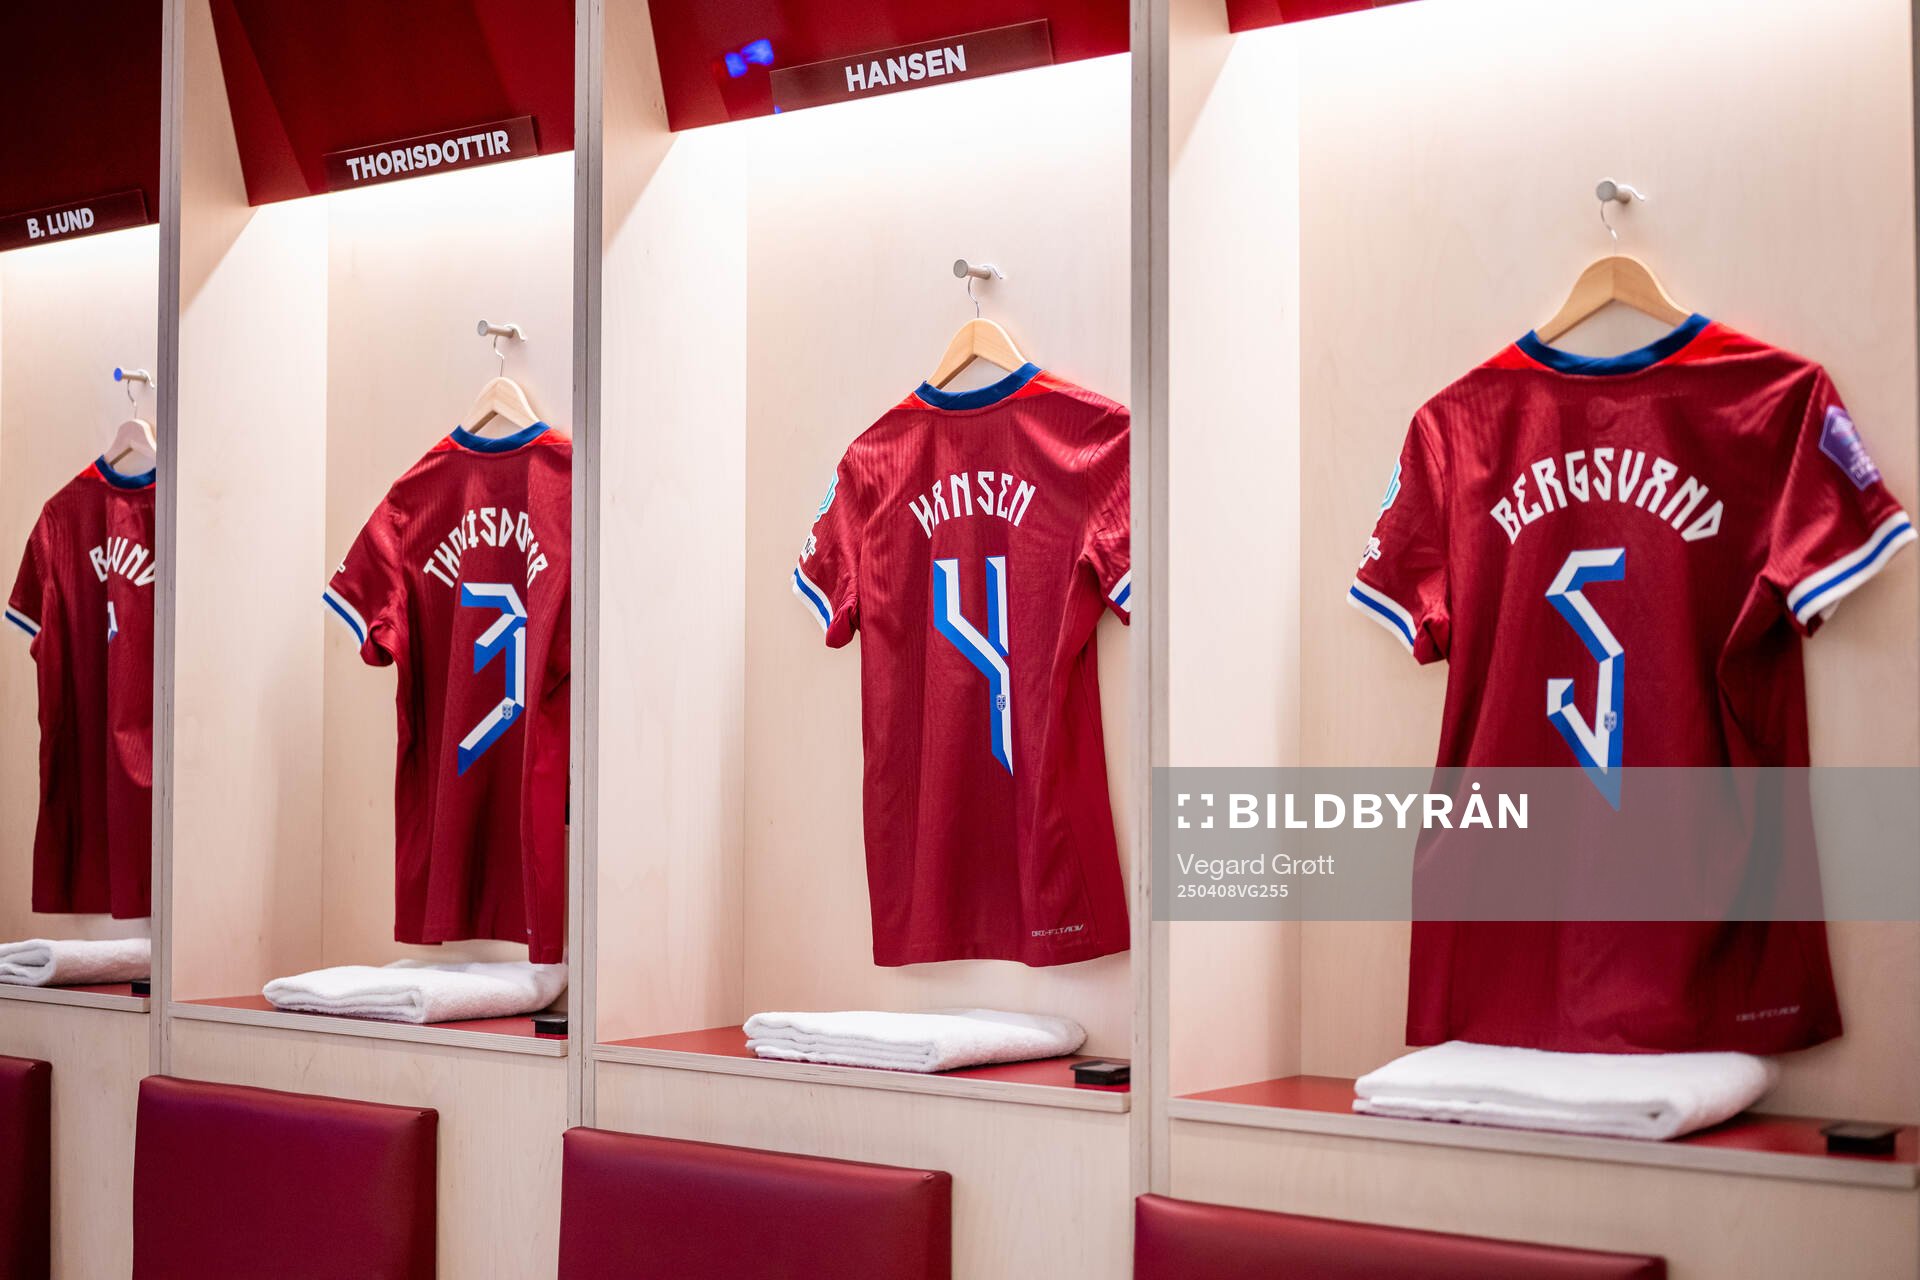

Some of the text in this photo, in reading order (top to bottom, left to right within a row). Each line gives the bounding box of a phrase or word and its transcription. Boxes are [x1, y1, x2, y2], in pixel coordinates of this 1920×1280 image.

[845, 44, 967, 92] HANSEN
[346, 129, 511, 181] THORISDOTTIR
[27, 207, 95, 240] B. LUND
[908, 470, 1037, 540] HANSEN
[1490, 447, 1724, 545] BERGSVAND
[932, 555, 1014, 777] 4
[1545, 547, 1626, 812] 5
